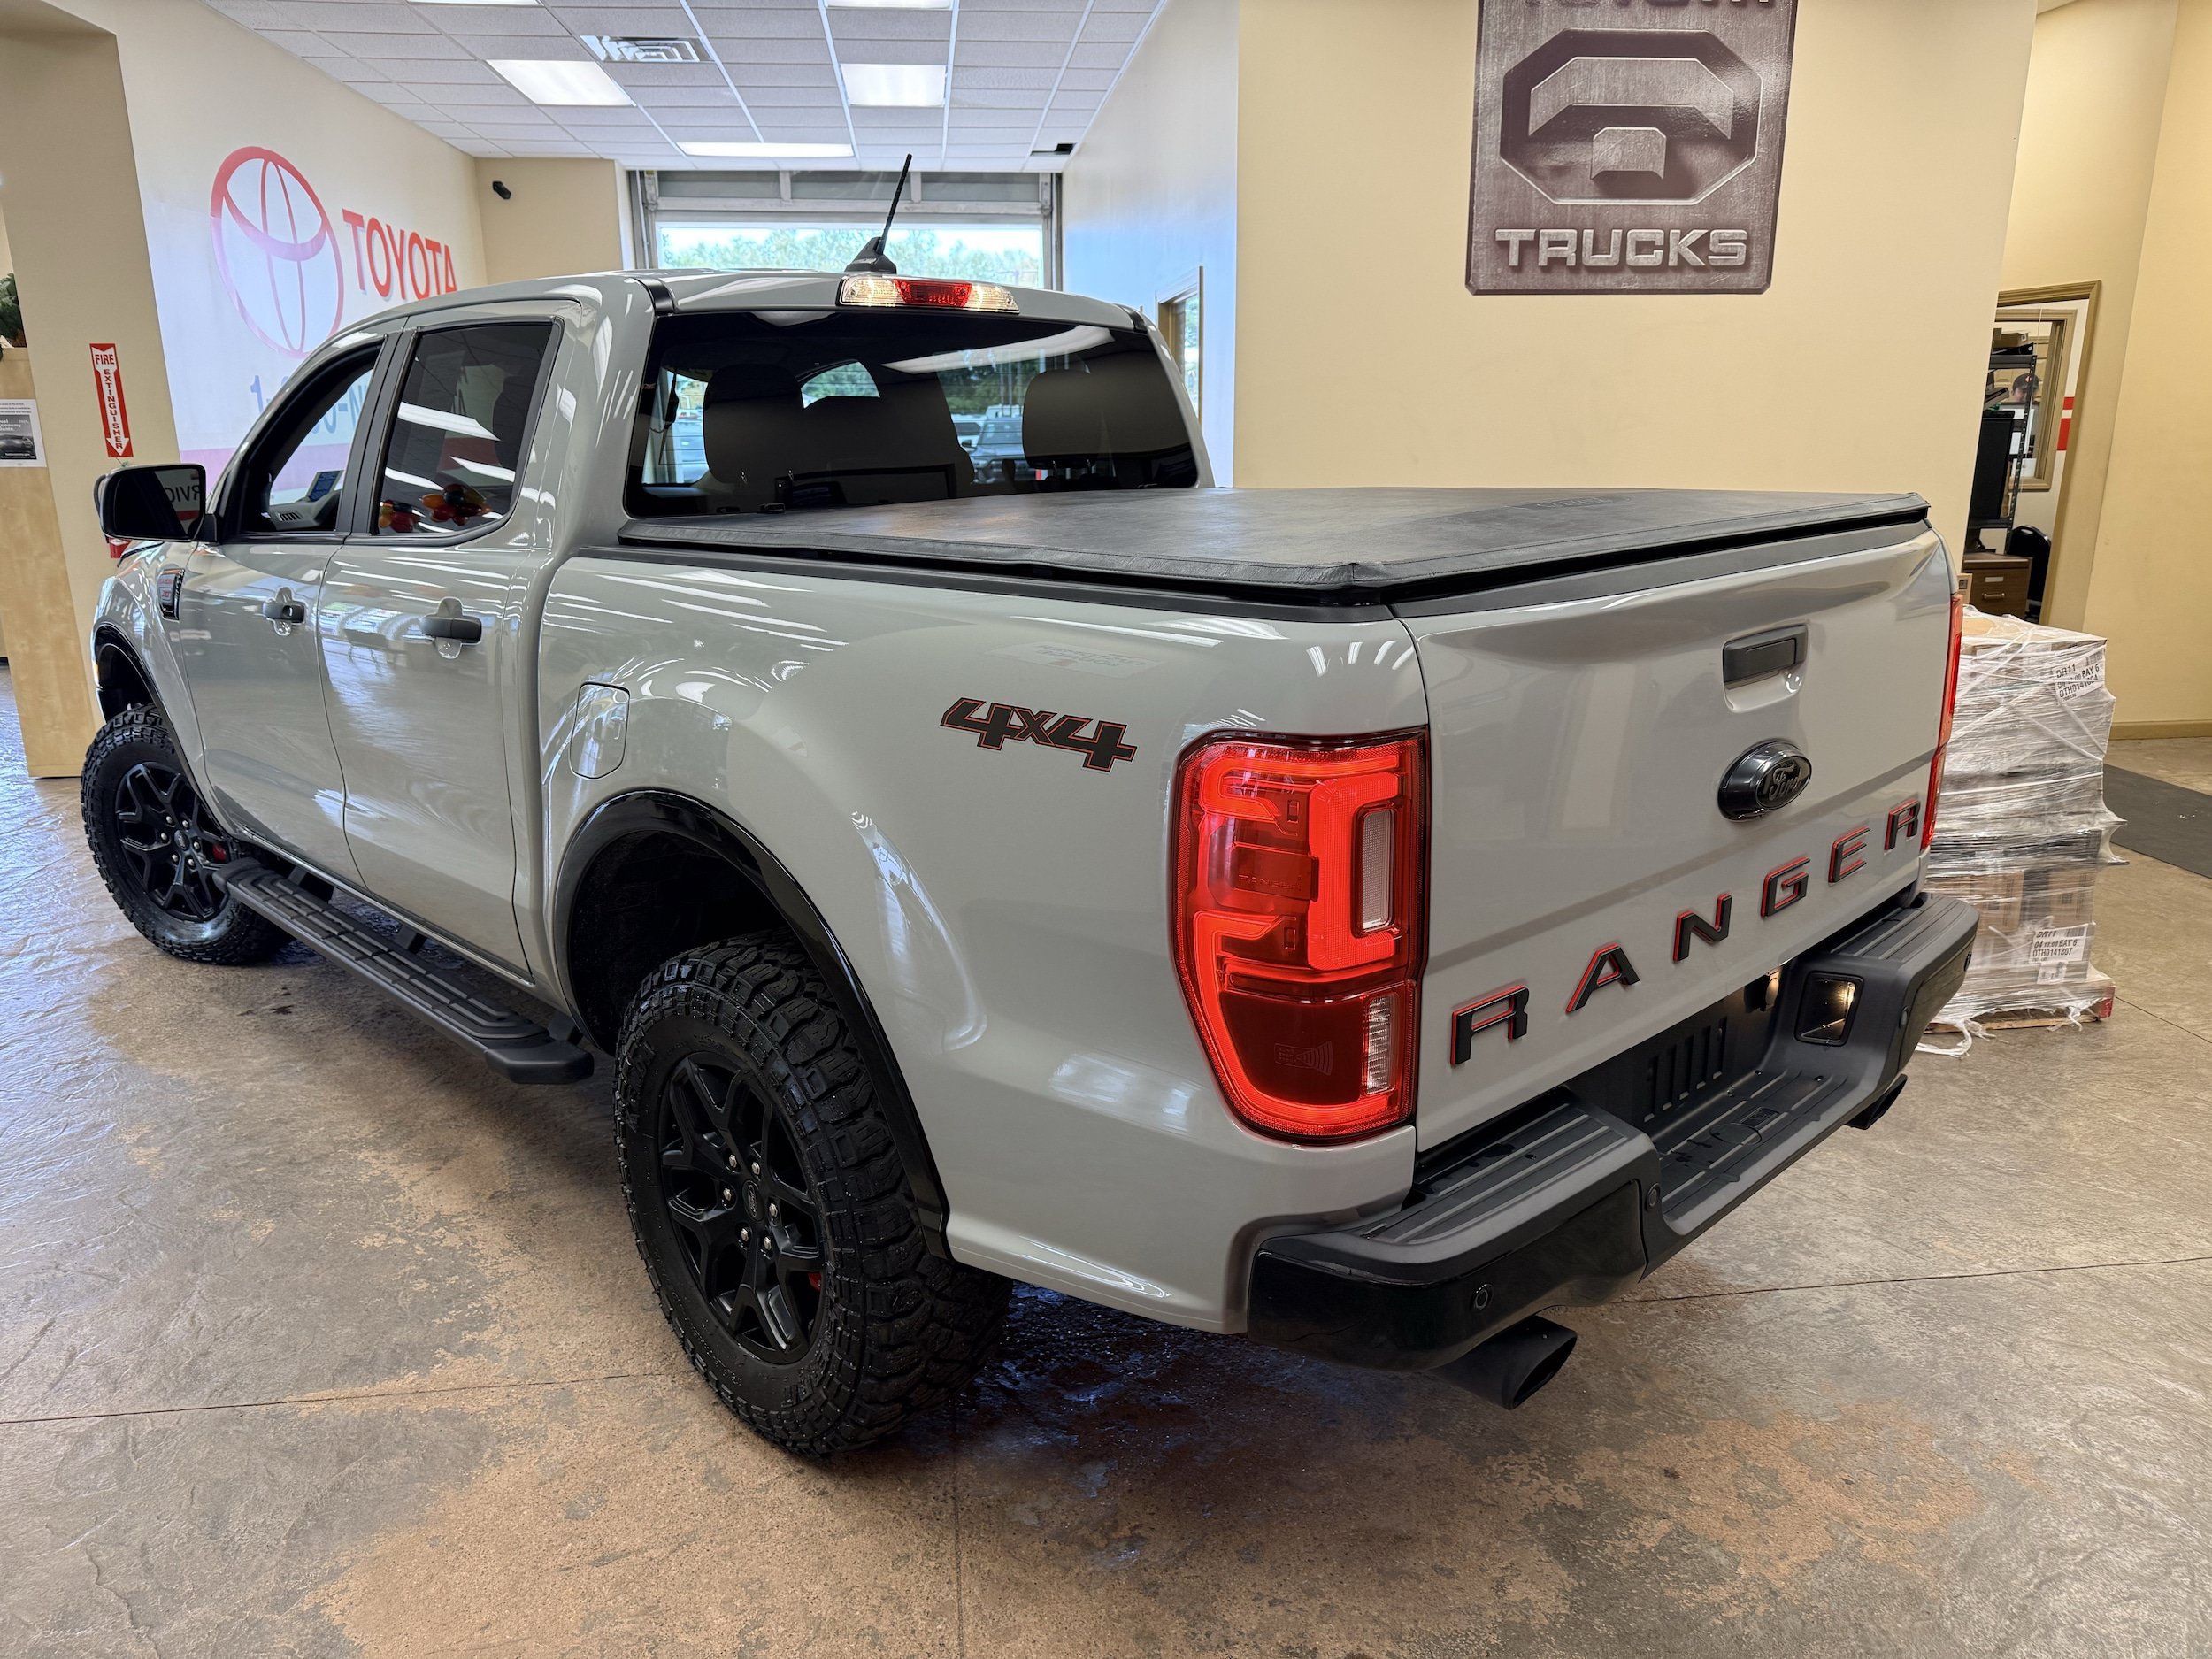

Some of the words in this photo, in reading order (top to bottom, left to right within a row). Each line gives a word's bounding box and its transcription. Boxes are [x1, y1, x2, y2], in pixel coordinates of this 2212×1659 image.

[342, 208, 457, 300] TOYOTA
[1494, 228, 1748, 266] TRUCKS
[95, 354, 115, 365] FIRE
[103, 368, 124, 449] EXTINGUISHER
[2081, 666, 2093, 679] BAY
[1450, 799, 1920, 1066] RANGER
[2058, 939, 2072, 948] BAY
